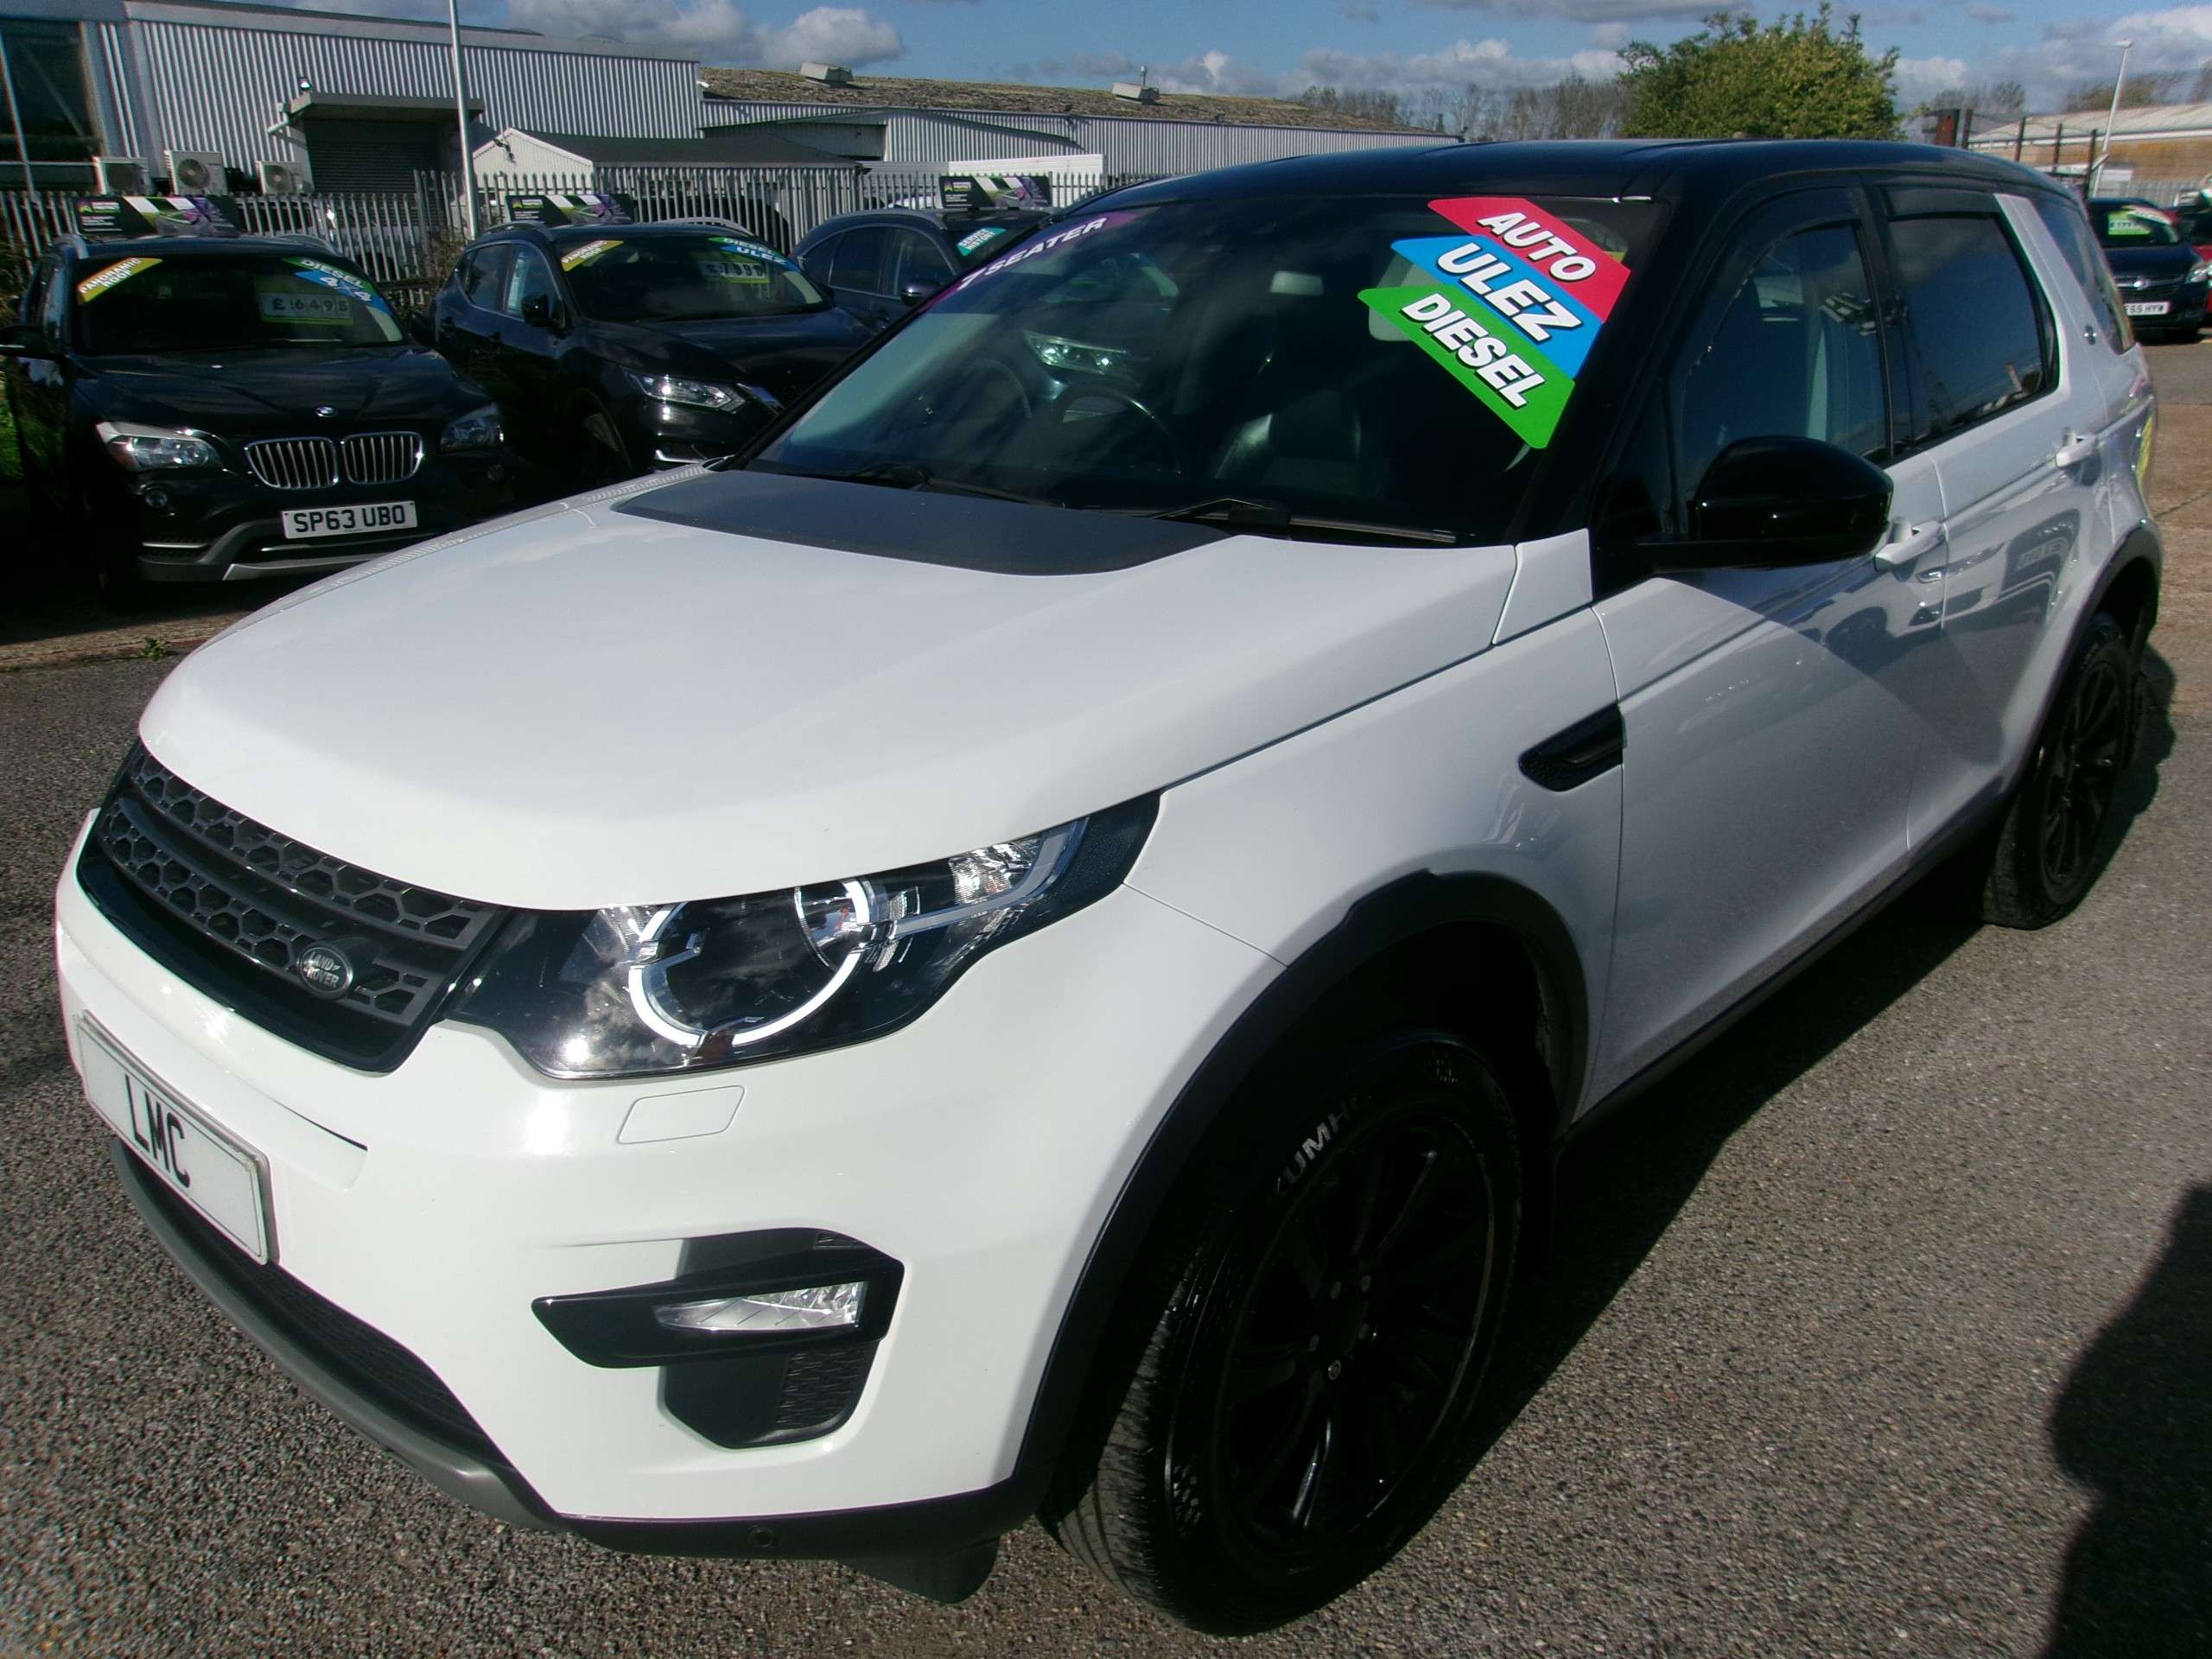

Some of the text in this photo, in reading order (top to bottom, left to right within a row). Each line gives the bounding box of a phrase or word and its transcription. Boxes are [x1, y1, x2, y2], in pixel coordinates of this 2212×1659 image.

[300, 258, 365, 288] DIESEL
[736, 246, 787, 264] ULEZ
[957, 218, 1107, 291] 7 SEATER
[1477, 212, 1598, 282] AUTO
[79, 257, 142, 294] PANORAMIC
[1436, 242, 1583, 344] ULEZ
[1402, 293, 1547, 408] DIESEL
[294, 509, 356, 533] SP63
